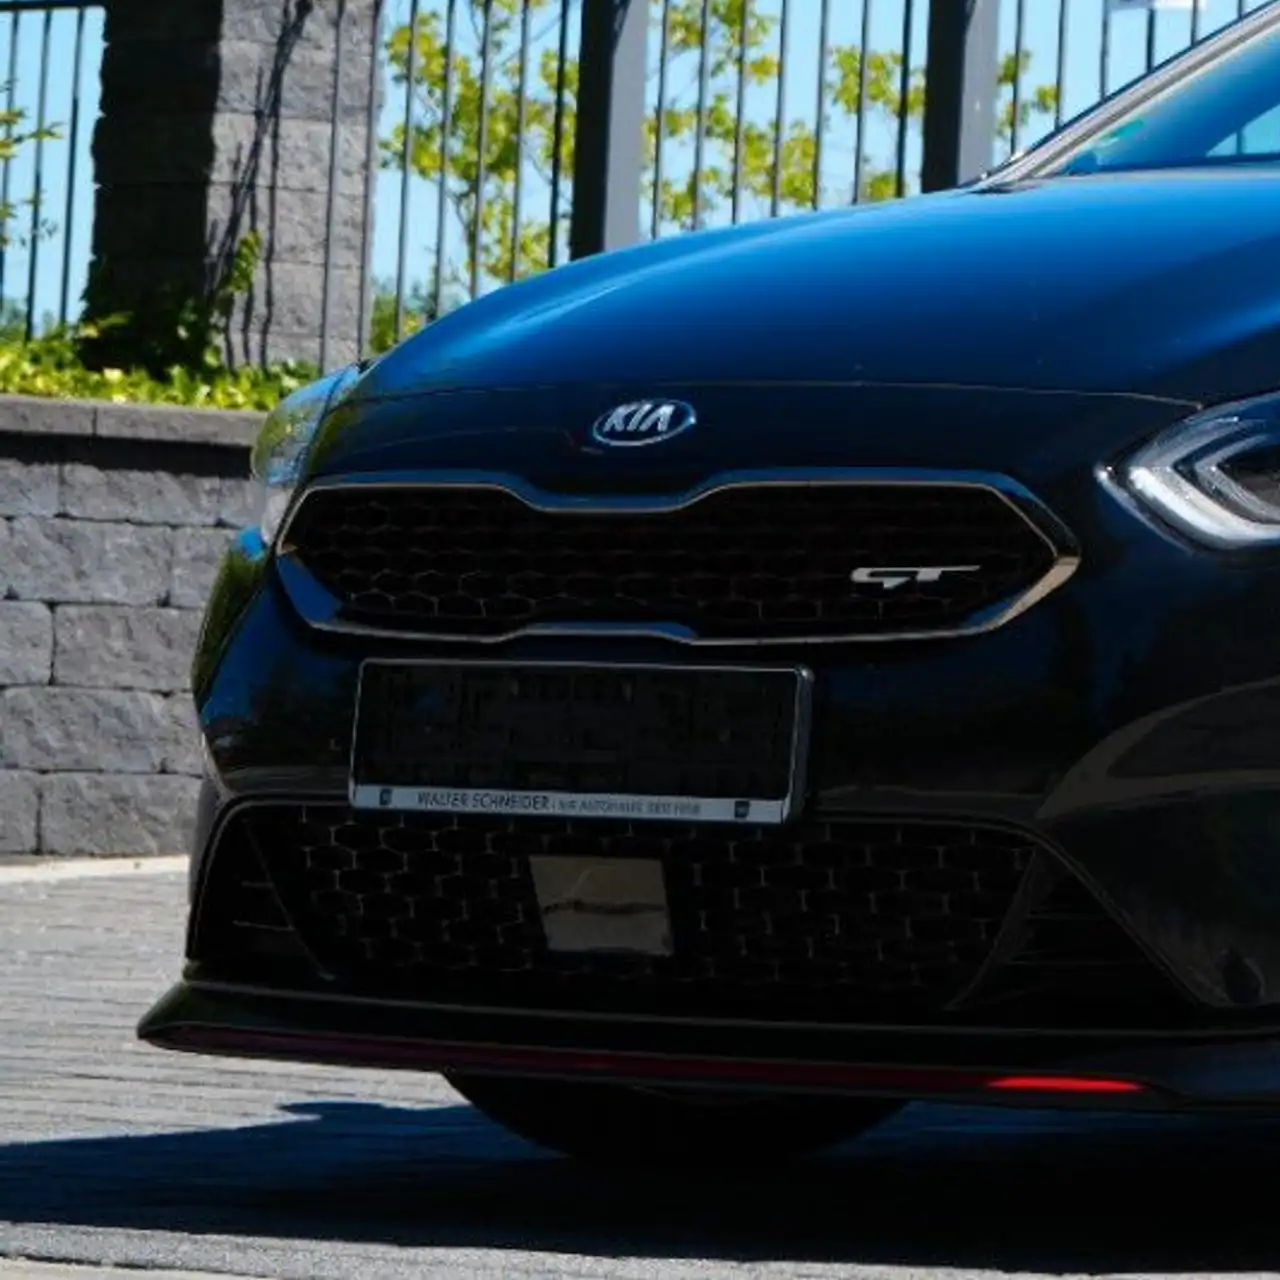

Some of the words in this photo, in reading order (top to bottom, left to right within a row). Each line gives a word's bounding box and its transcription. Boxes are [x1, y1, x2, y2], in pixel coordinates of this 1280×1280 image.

[603, 403, 675, 433] KIA
[850, 564, 982, 589] GT
[417, 792, 469, 806] WALTER
[473, 793, 550, 811] SCHNEIDER
